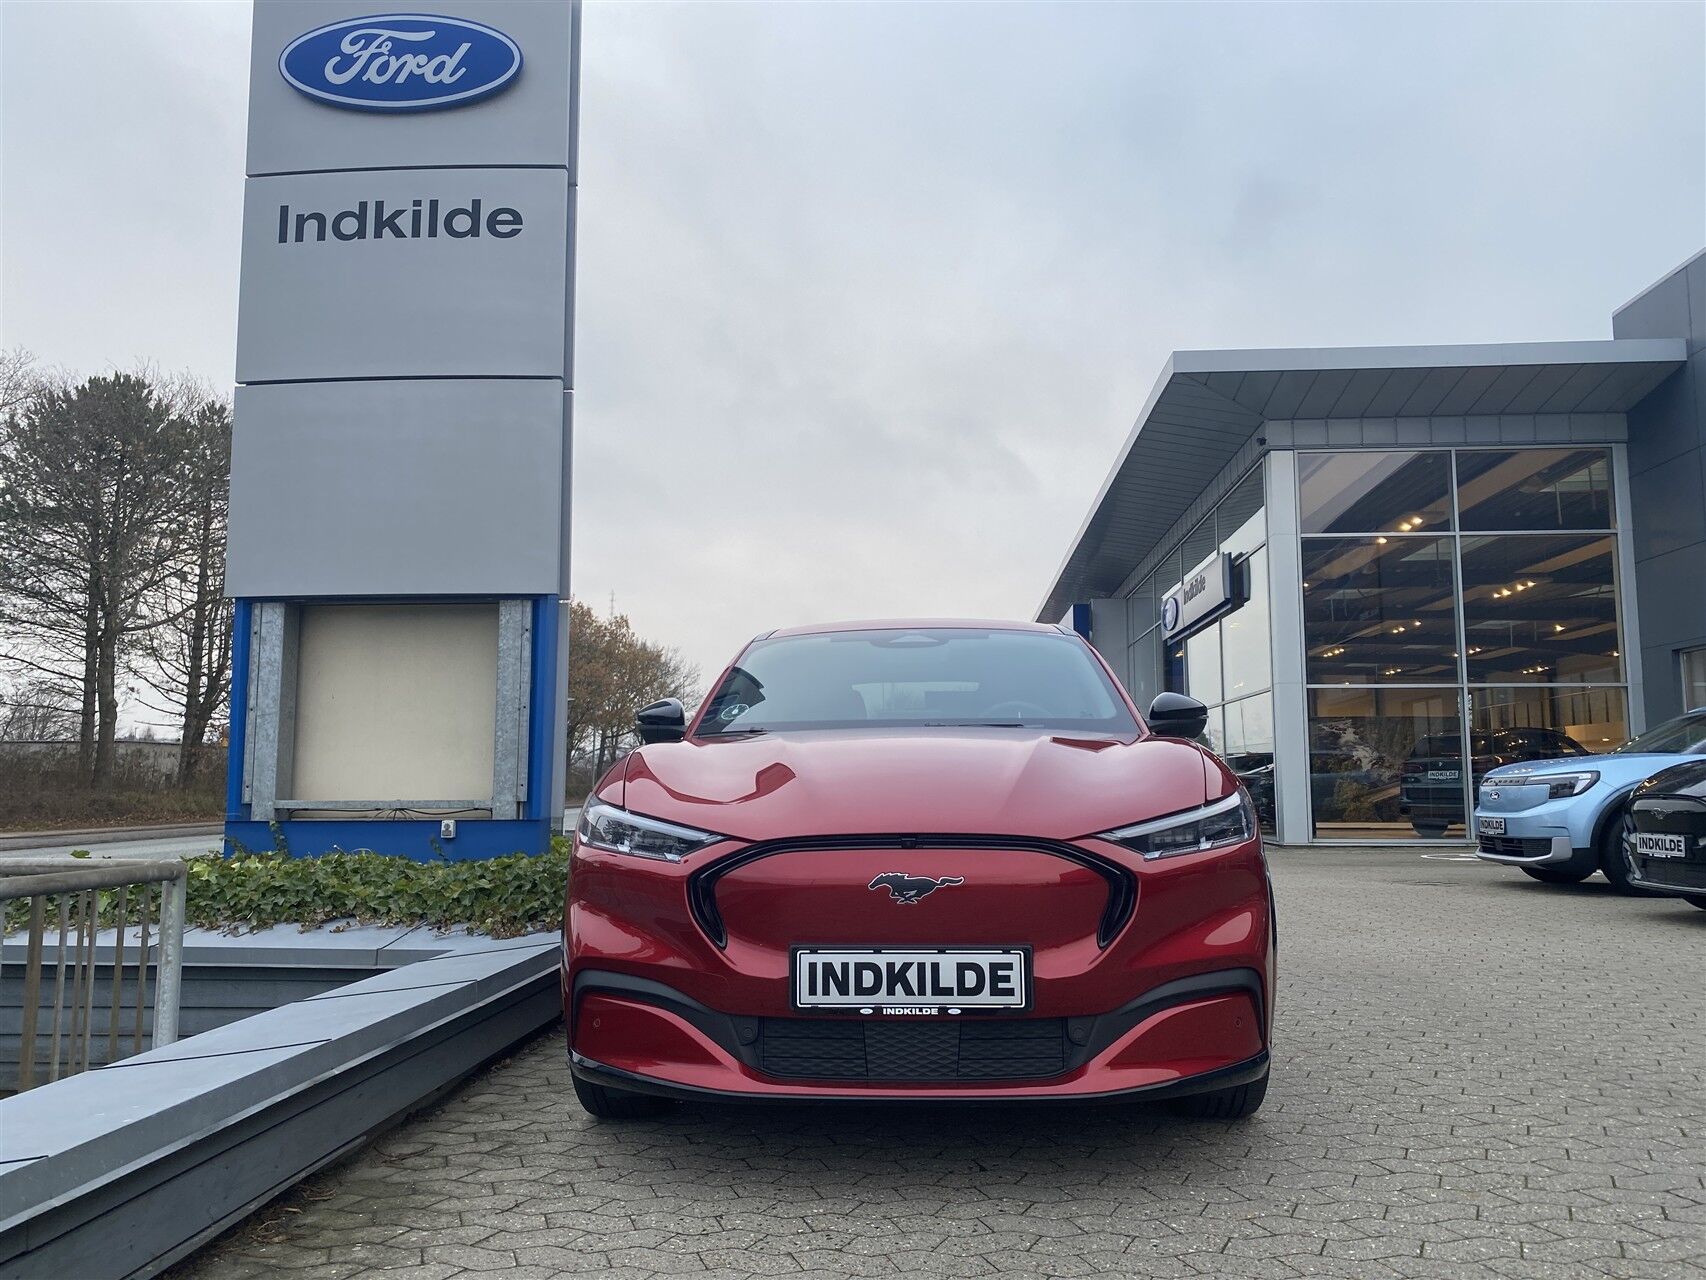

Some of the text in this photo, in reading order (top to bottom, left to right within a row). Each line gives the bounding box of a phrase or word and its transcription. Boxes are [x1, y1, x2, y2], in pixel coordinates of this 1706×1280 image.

[324, 28, 472, 85] Ford
[278, 198, 524, 244] Indkilde
[1638, 836, 1683, 853] INDKILDE
[807, 961, 1016, 997] INDKILDE
[882, 1007, 939, 1015] INDKILDE
